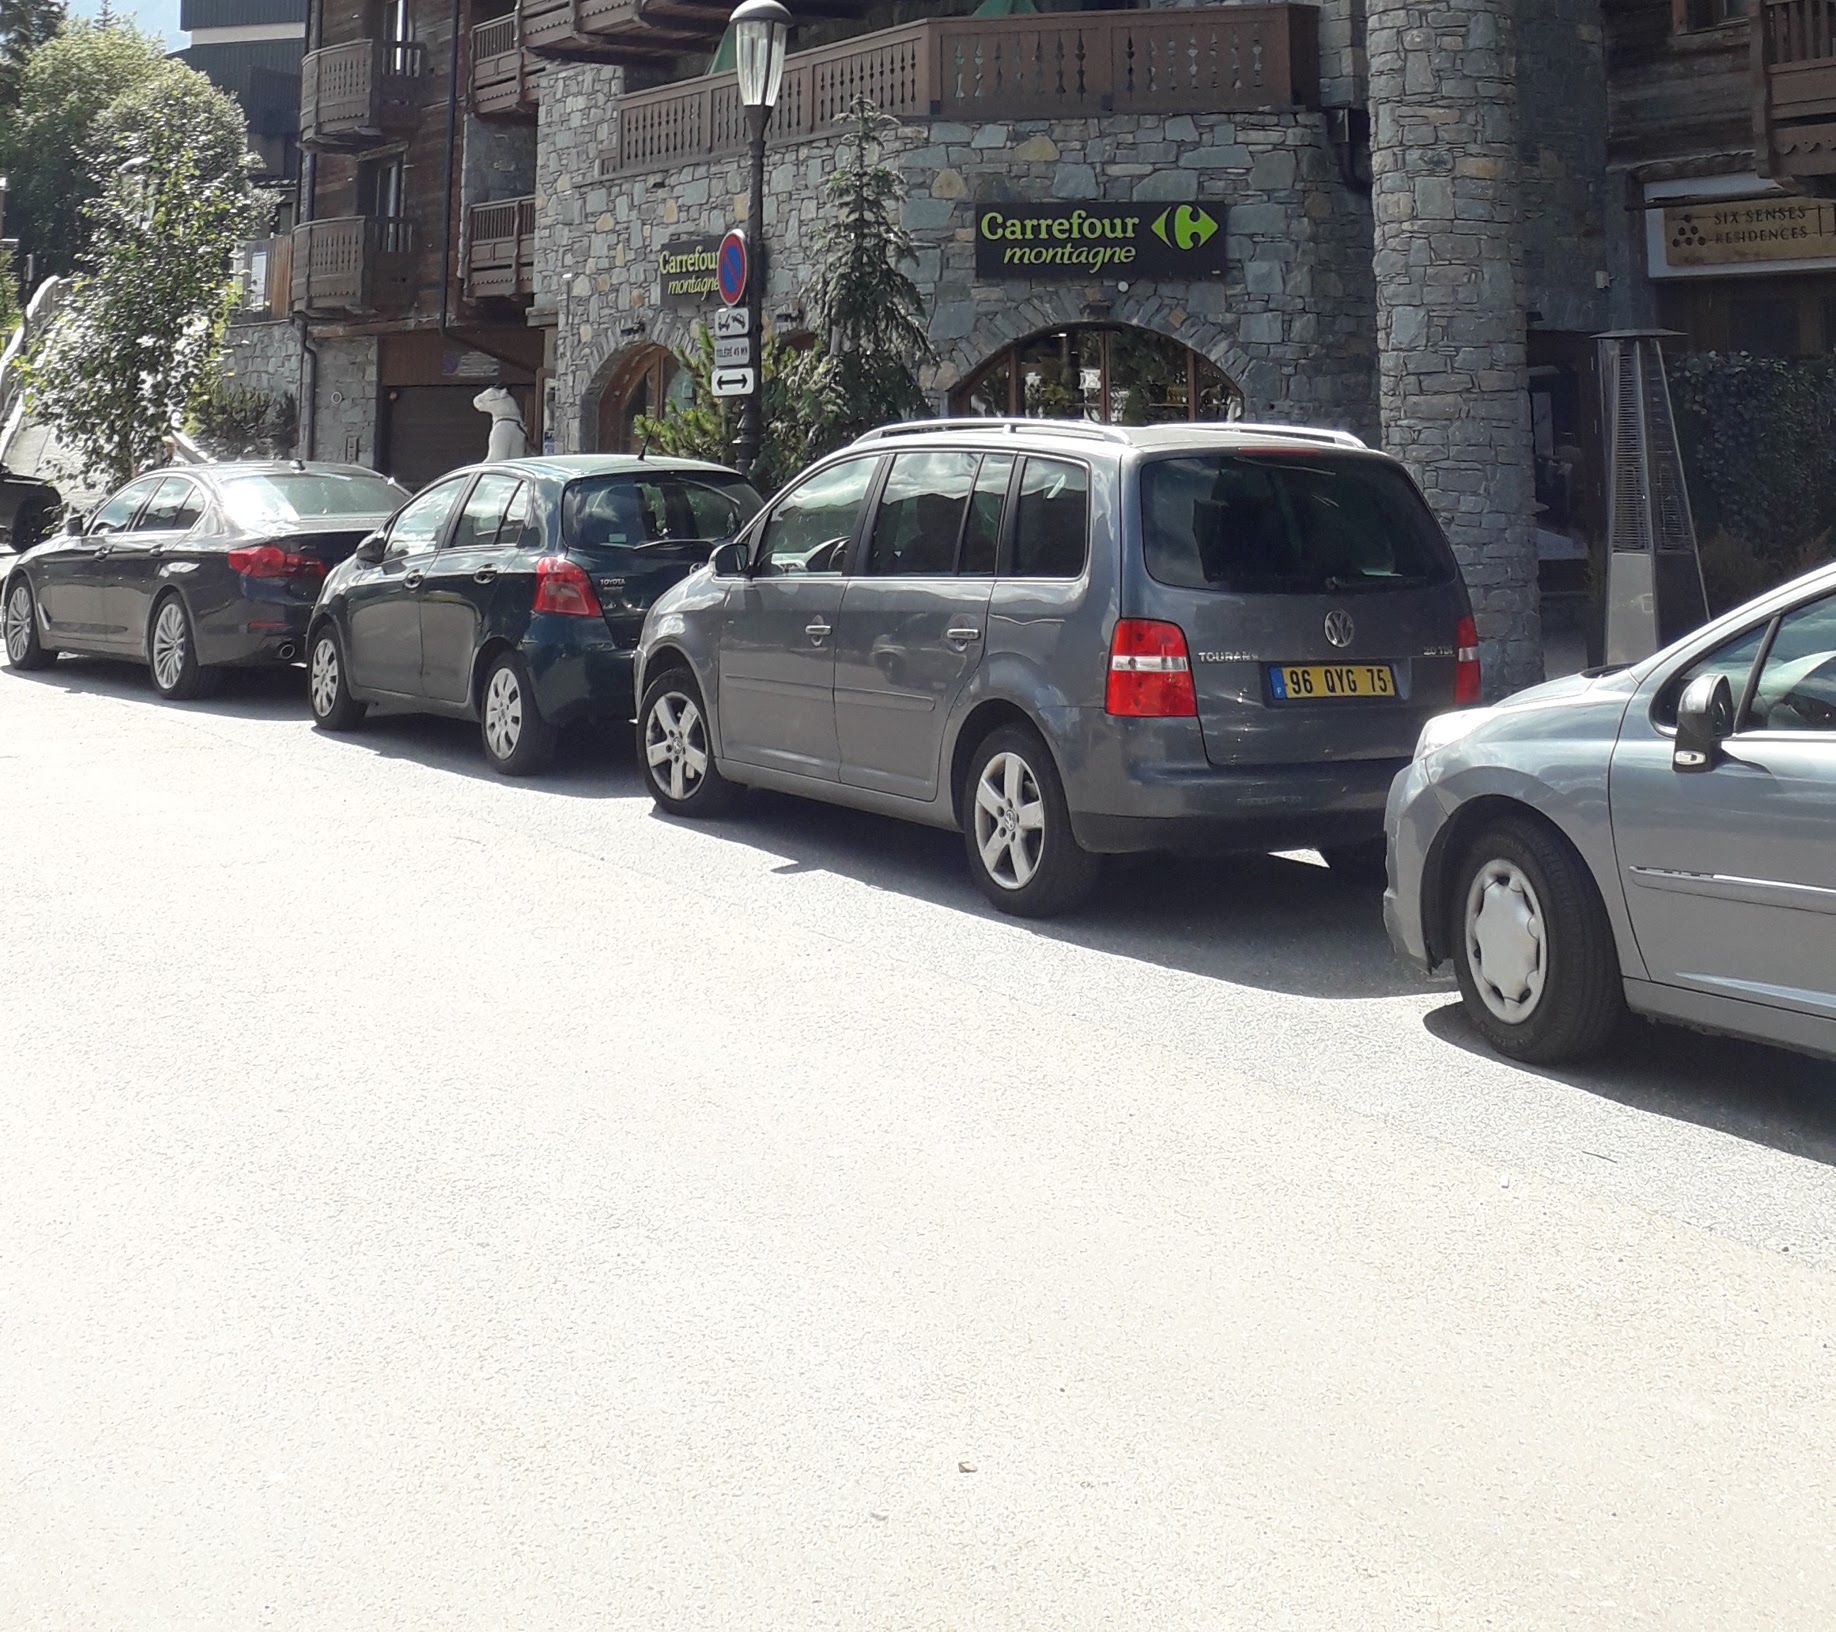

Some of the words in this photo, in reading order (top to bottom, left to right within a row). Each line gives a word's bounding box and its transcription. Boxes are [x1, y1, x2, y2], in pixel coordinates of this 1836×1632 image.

[981, 209, 1140, 240] Carrefour
[1714, 211, 1739, 225] SIX
[1745, 205, 1806, 223] SENSES
[1715, 225, 1808, 245] RESIDENCES
[1003, 242, 1136, 274] montagne
[1289, 669, 1314, 695] 96
[1323, 668, 1358, 693] QYG
[1366, 668, 1388, 693] 75
